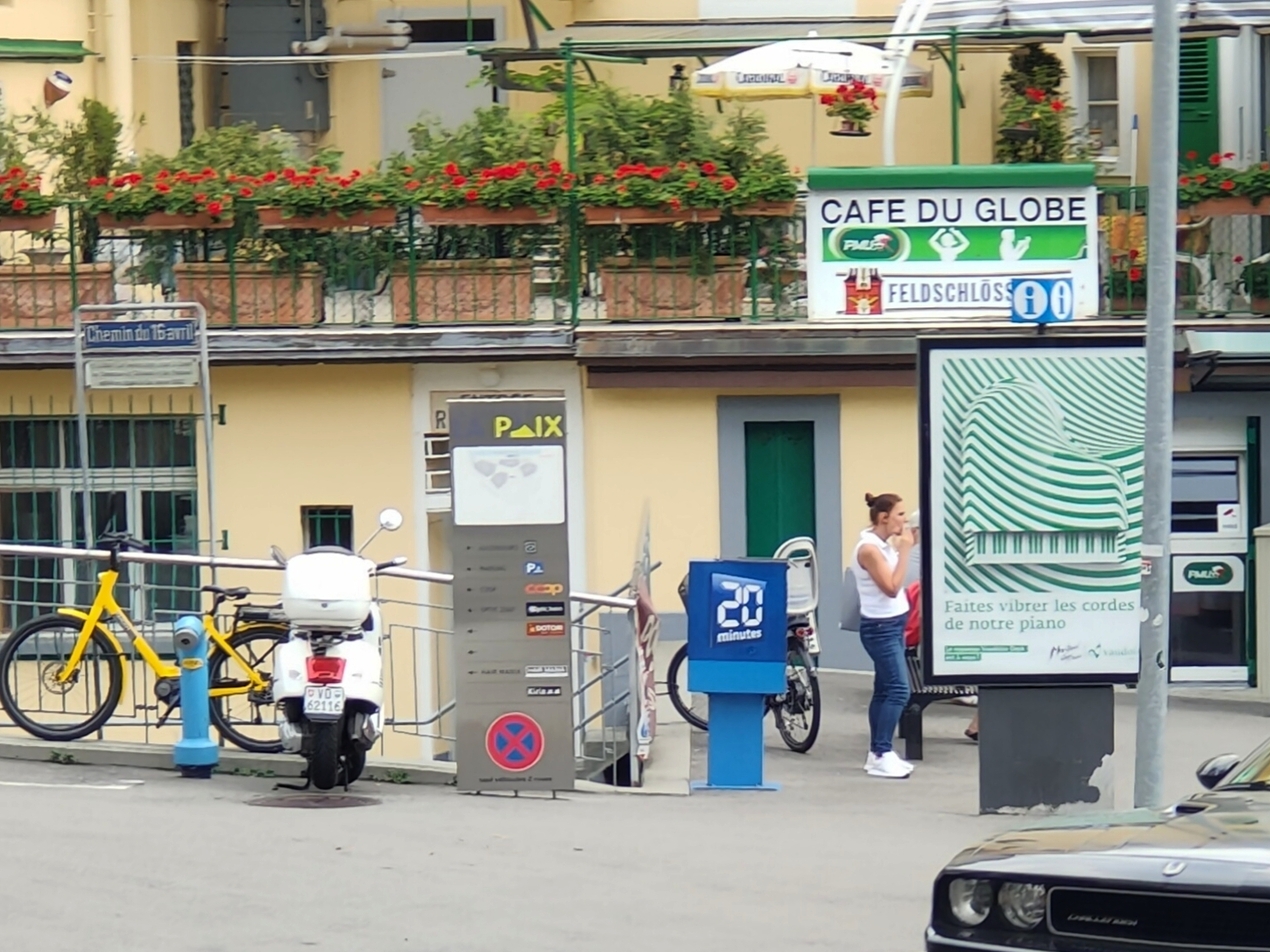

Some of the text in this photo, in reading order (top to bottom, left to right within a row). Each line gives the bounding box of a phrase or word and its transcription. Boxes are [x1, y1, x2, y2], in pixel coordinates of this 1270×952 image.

[820, 197, 1087, 224] CAFE DU GLOBE
[87, 325, 134, 342] Chemin
[135, 324, 150, 341] du
[717, 581, 763, 628] 20
[945, 598, 1135, 613] Faites vibrer les cordes
[945, 618, 1066, 633] de notre piano
[717, 629, 763, 643] minutes
[307, 701, 341, 712] 62116
